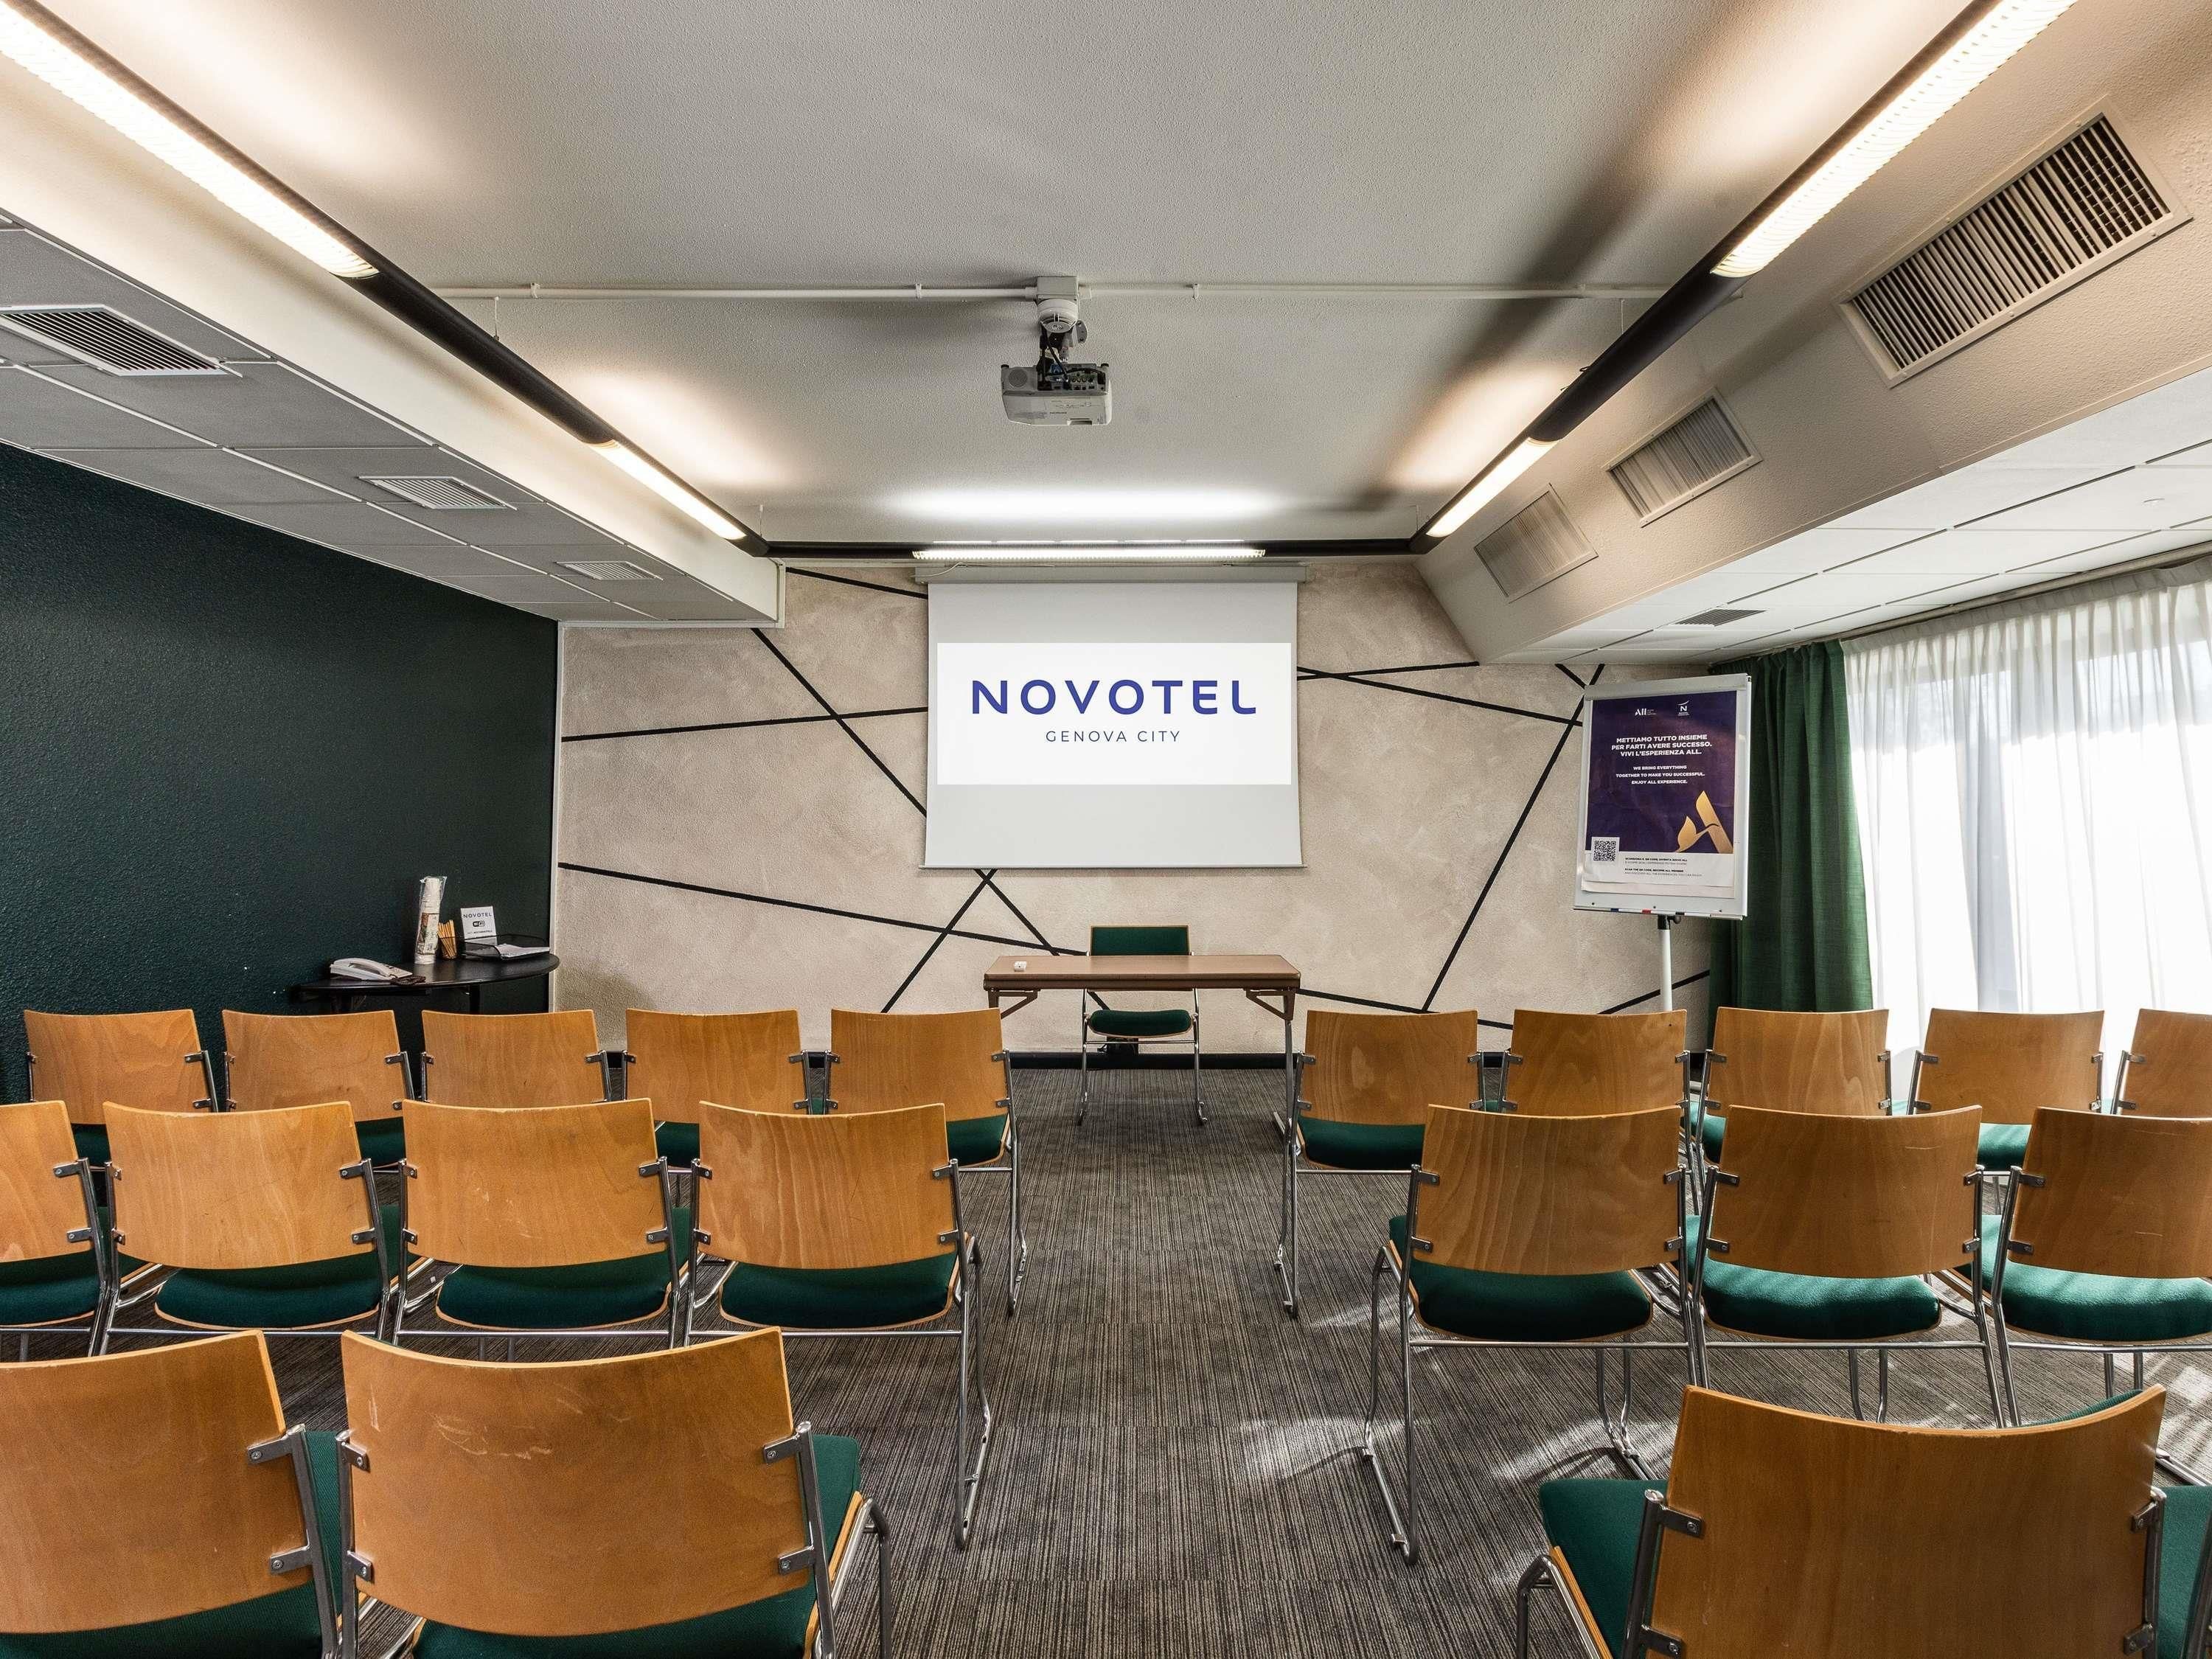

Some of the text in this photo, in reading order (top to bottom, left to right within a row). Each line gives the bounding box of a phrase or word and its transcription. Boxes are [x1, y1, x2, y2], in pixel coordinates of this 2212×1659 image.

[972, 679, 1256, 715] NOVOTEL
[1046, 731, 1180, 742] GENOVA CITY
